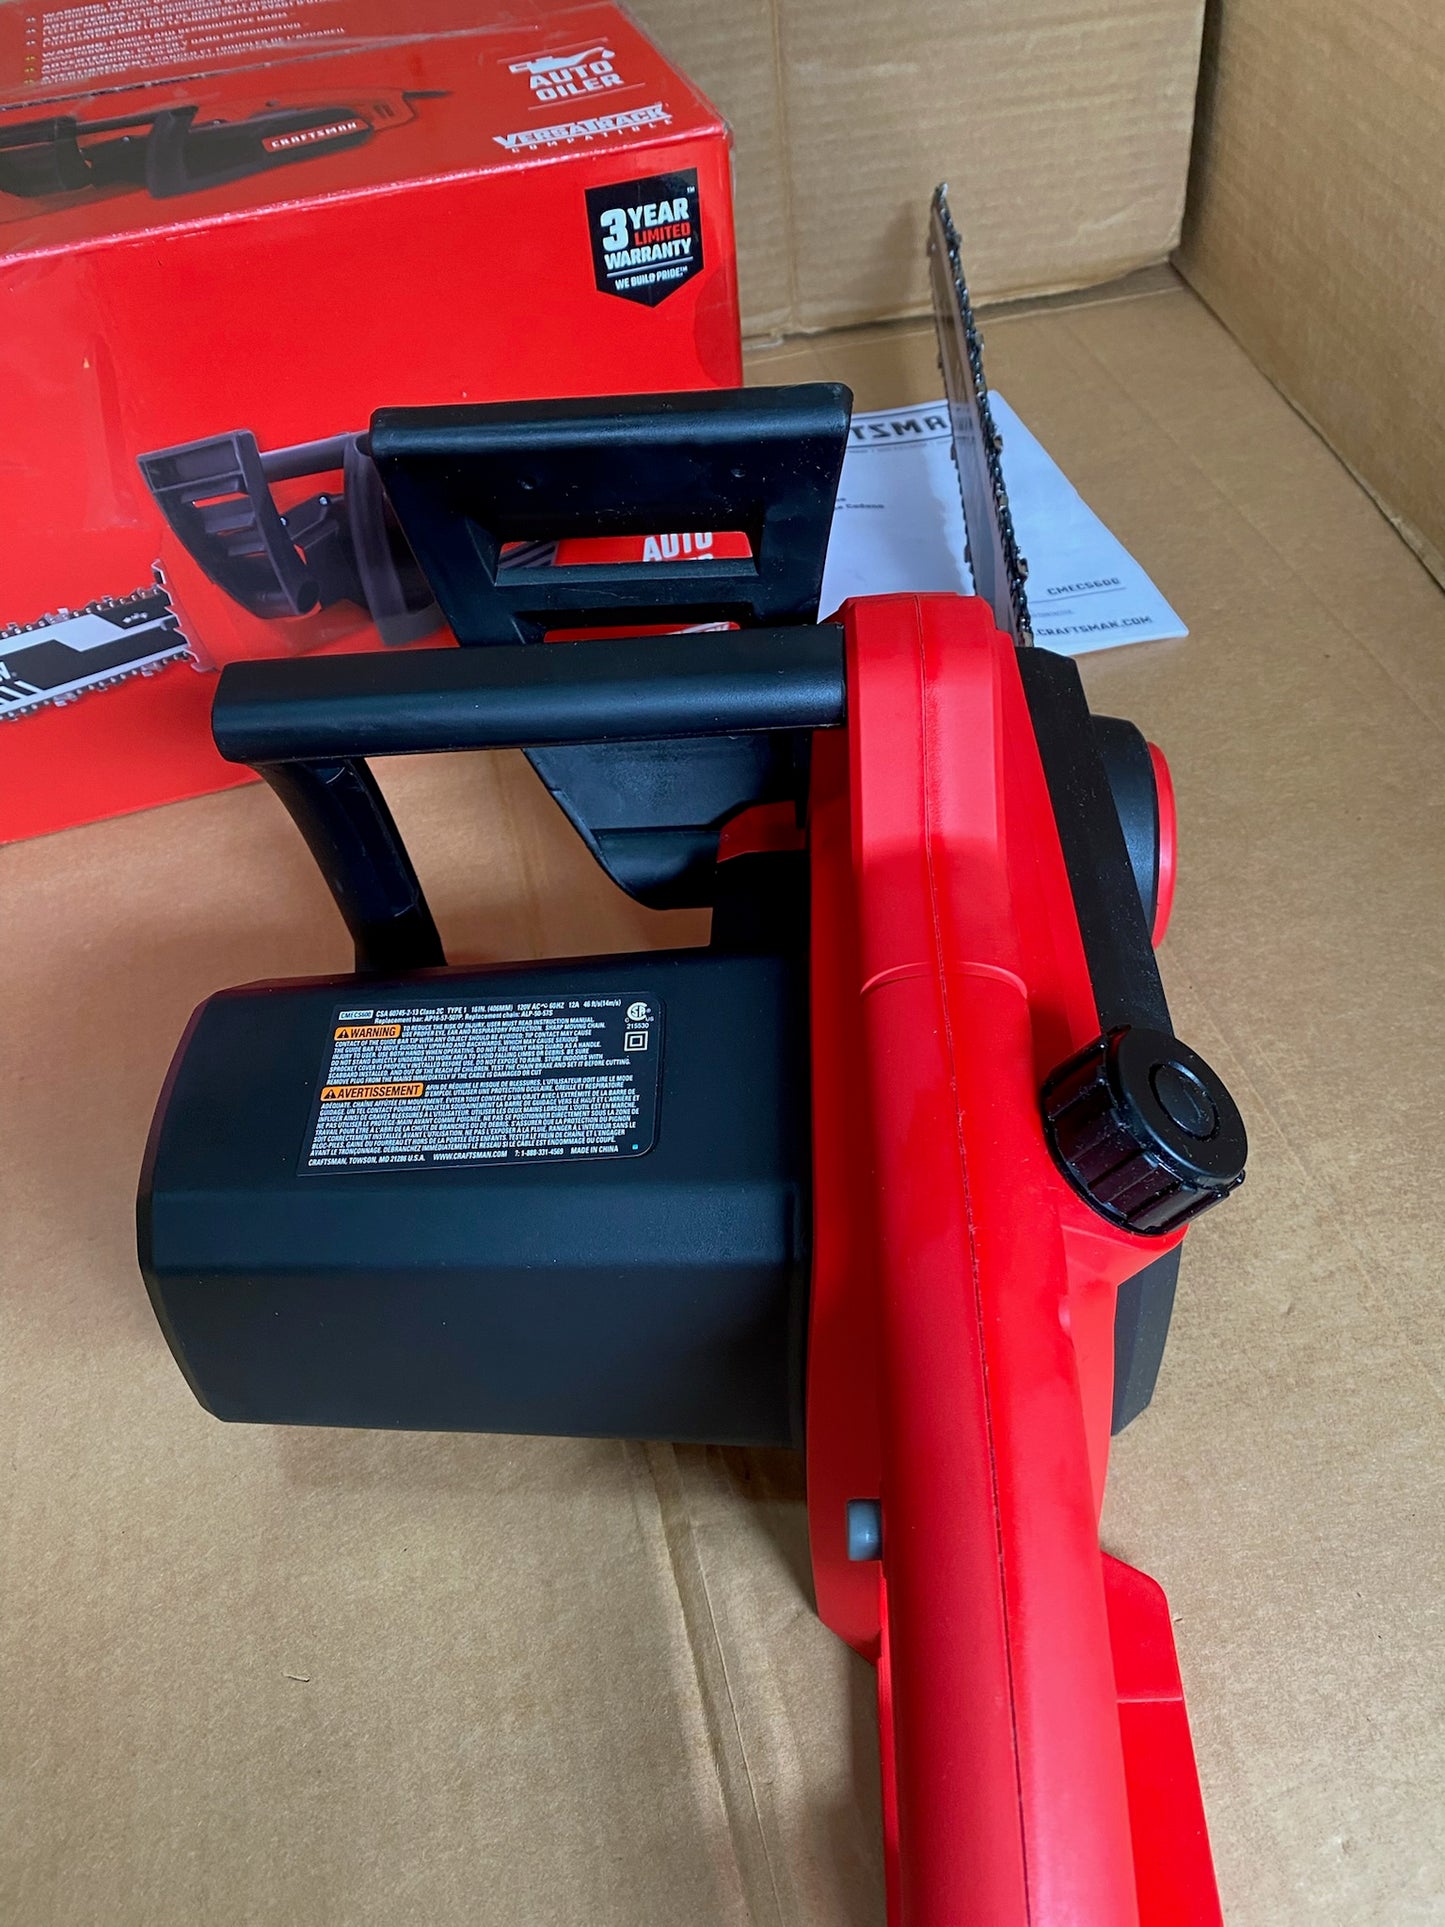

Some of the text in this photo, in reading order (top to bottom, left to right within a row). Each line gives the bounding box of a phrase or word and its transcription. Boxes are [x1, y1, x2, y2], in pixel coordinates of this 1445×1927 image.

[530, 60, 614, 89] AUTO
[536, 72, 624, 101] OILER
[271, 121, 358, 149] CRAFTSMAN
[600, 208, 629, 252] 3
[627, 197, 690, 230] YEAR
[634, 222, 691, 246] LIMITED
[604, 237, 692, 271] WARRANTY
[615, 277, 630, 290] WE
[631, 272, 656, 287] BUILD
[642, 532, 713, 562] AUTO
[349, 1026, 396, 1037] WARNING
[337, 1084, 420, 1098] AVERTISSEMENT
[377, 1156, 389, 1164] MD
[406, 1154, 426, 1162] U.S.A.
[432, 1150, 508, 1162] WWW.CRAFTSMAN.COM
[570, 1147, 589, 1155] MADE
[590, 1146, 597, 1154] IN
[598, 1145, 618, 1153] CHINA
